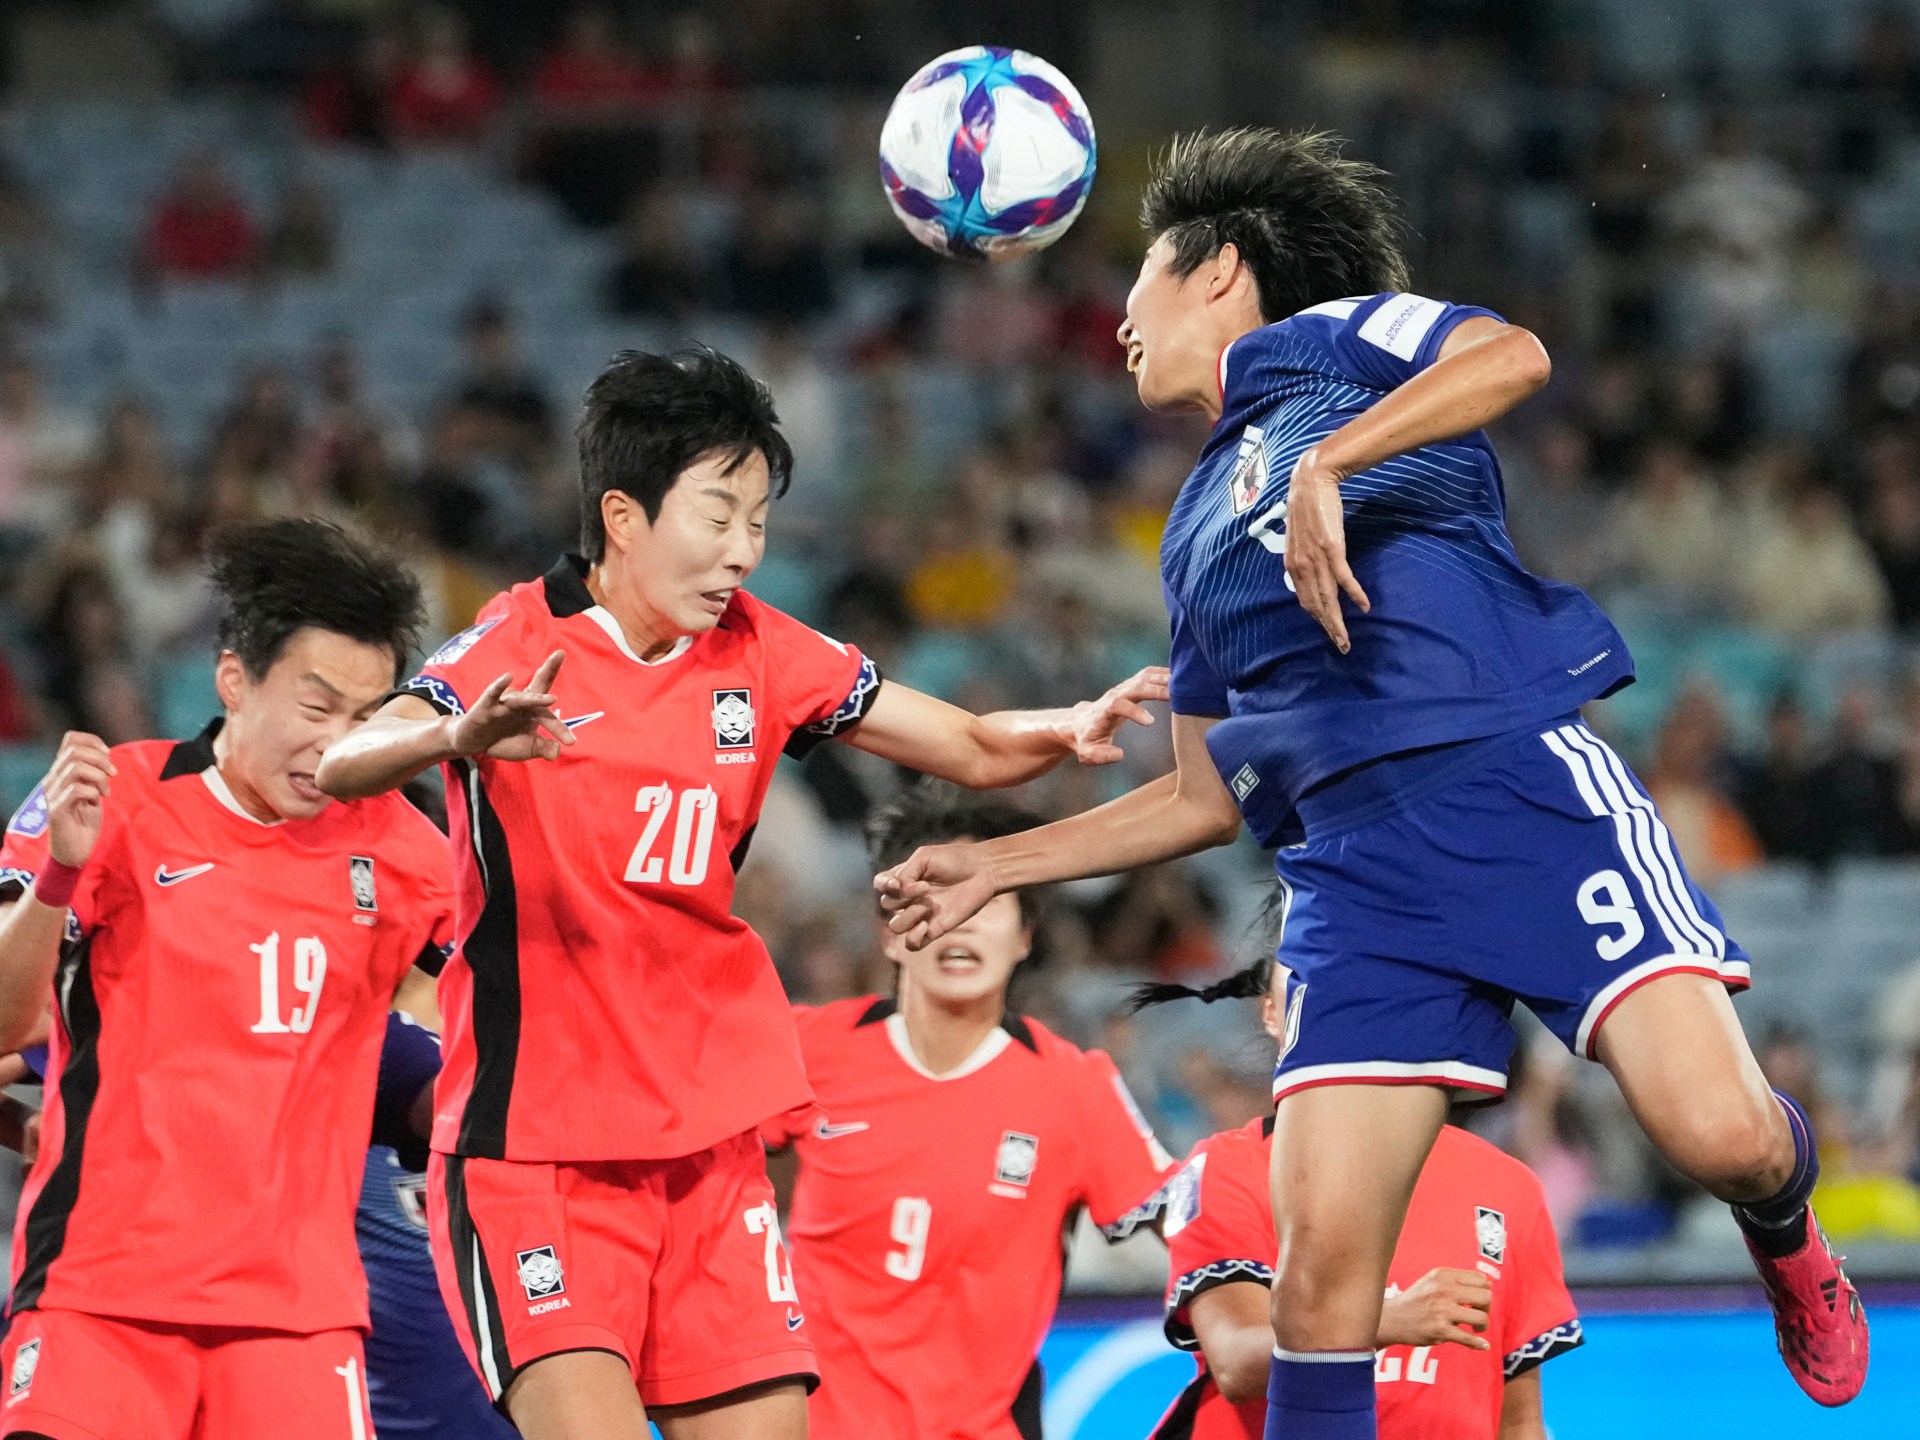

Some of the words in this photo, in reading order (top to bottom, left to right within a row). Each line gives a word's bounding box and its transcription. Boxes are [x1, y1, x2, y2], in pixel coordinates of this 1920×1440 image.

[1385, 305, 1414, 337] DREAM
[1387, 301, 1426, 347] FEARLESS
[715, 752, 757, 764] KOREA
[624, 781, 717, 886] 20
[1577, 869, 1645, 961] 9
[249, 931, 327, 1034] 19
[743, 1200, 799, 1305] 2
[886, 1197, 931, 1281] 9
[527, 1297, 571, 1316] KOREA
